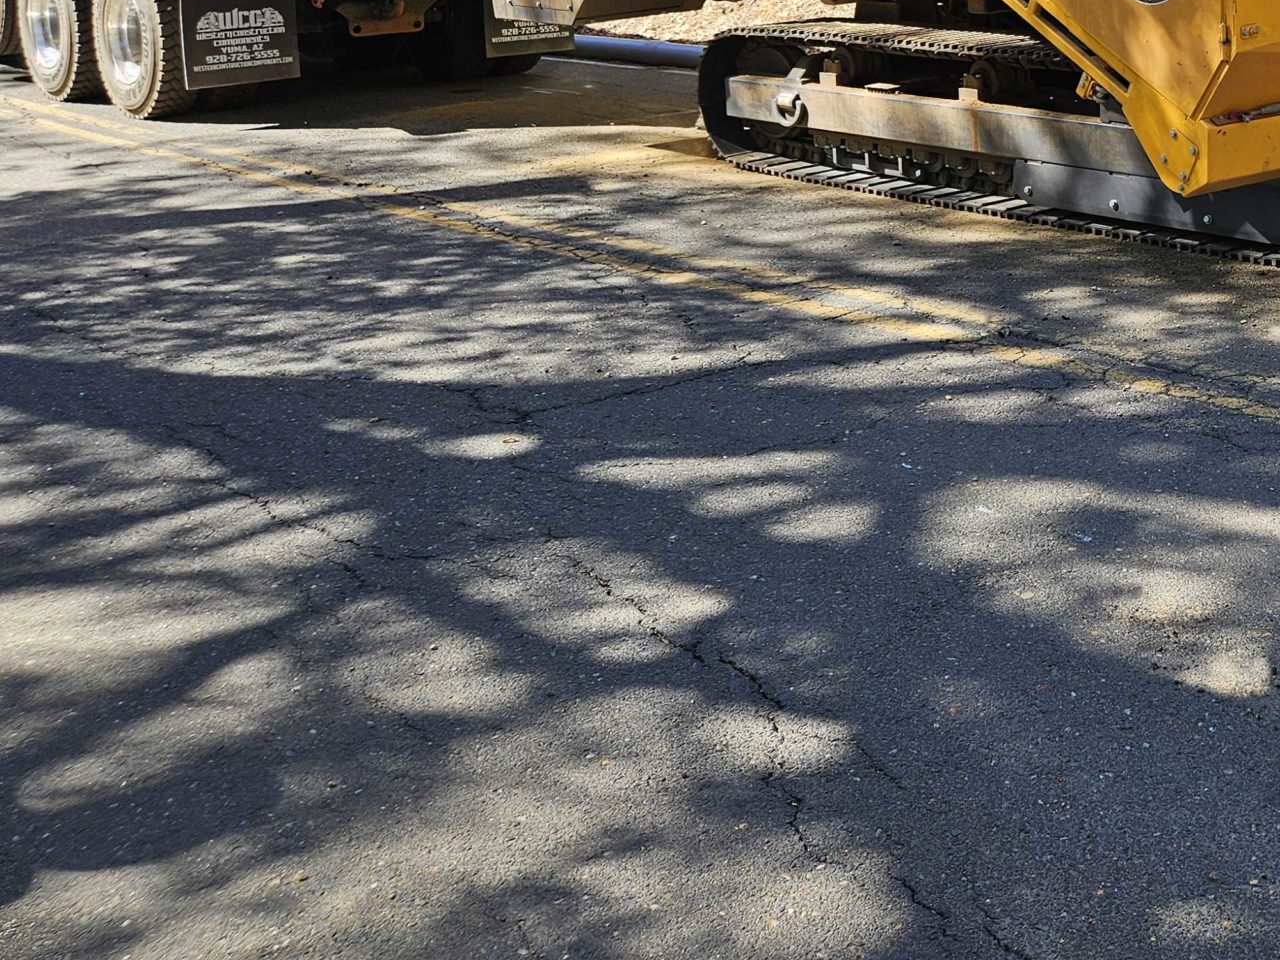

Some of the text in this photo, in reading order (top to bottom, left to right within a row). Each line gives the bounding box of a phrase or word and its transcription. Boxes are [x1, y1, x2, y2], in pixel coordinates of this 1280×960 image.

[501, 25, 560, 37] 928-726-5555
[252, 43, 264, 51] AZ
[205, 49, 280, 64] 928-726-5555
